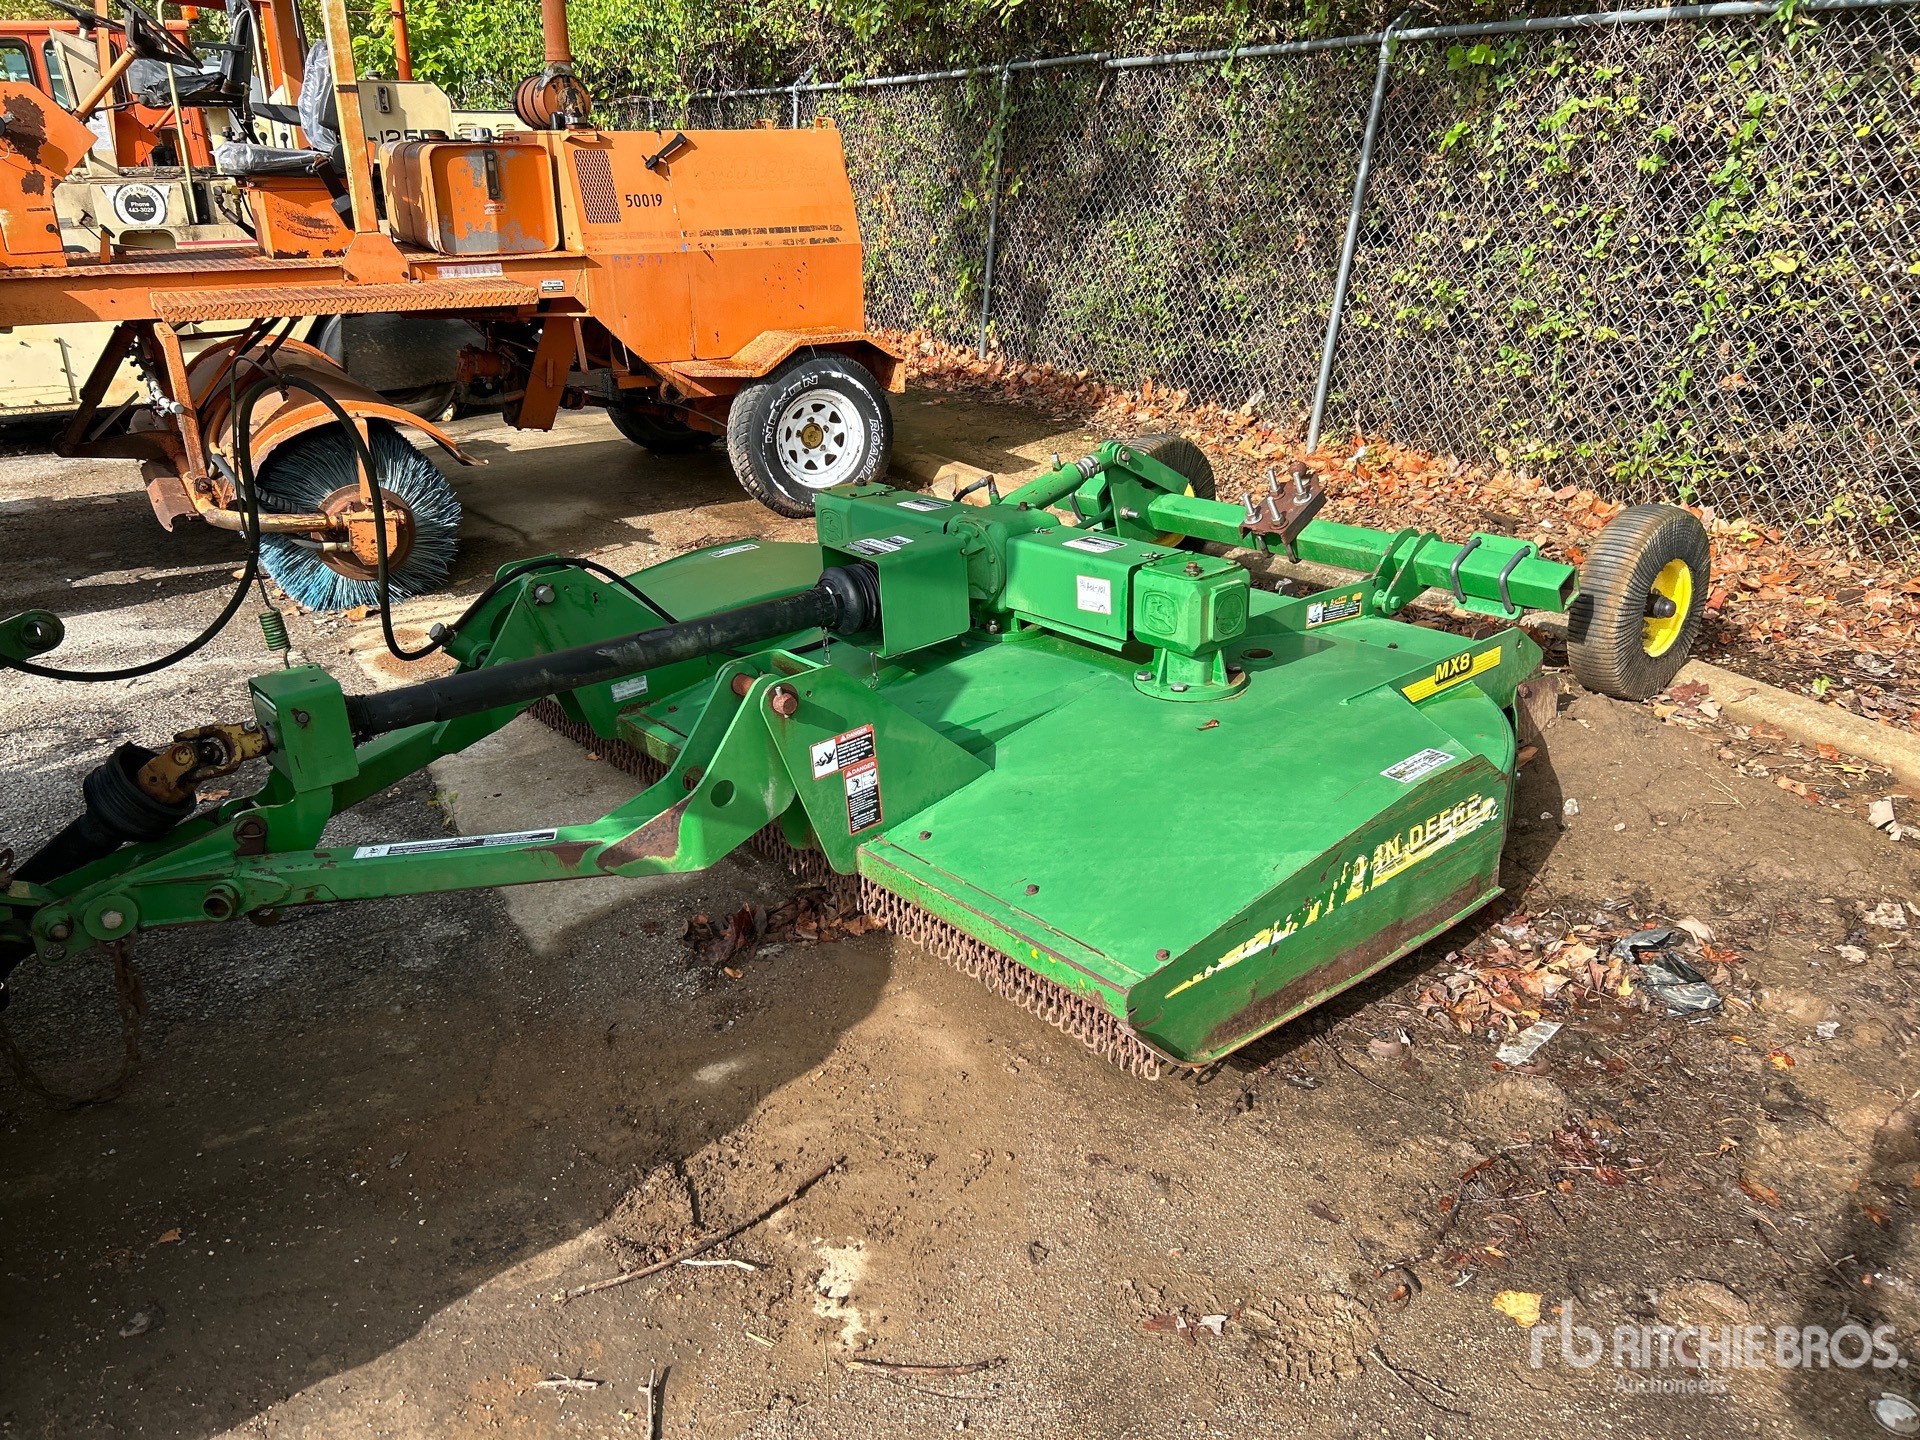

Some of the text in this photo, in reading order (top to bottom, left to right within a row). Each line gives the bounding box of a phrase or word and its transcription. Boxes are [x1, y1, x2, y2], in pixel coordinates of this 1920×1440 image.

[625, 193, 662, 208] 50019
[764, 375, 819, 444] NEXEN
[1435, 652, 1473, 686] MX8
[846, 727, 868, 740] DANGER
[851, 761, 875, 774] DANGER
